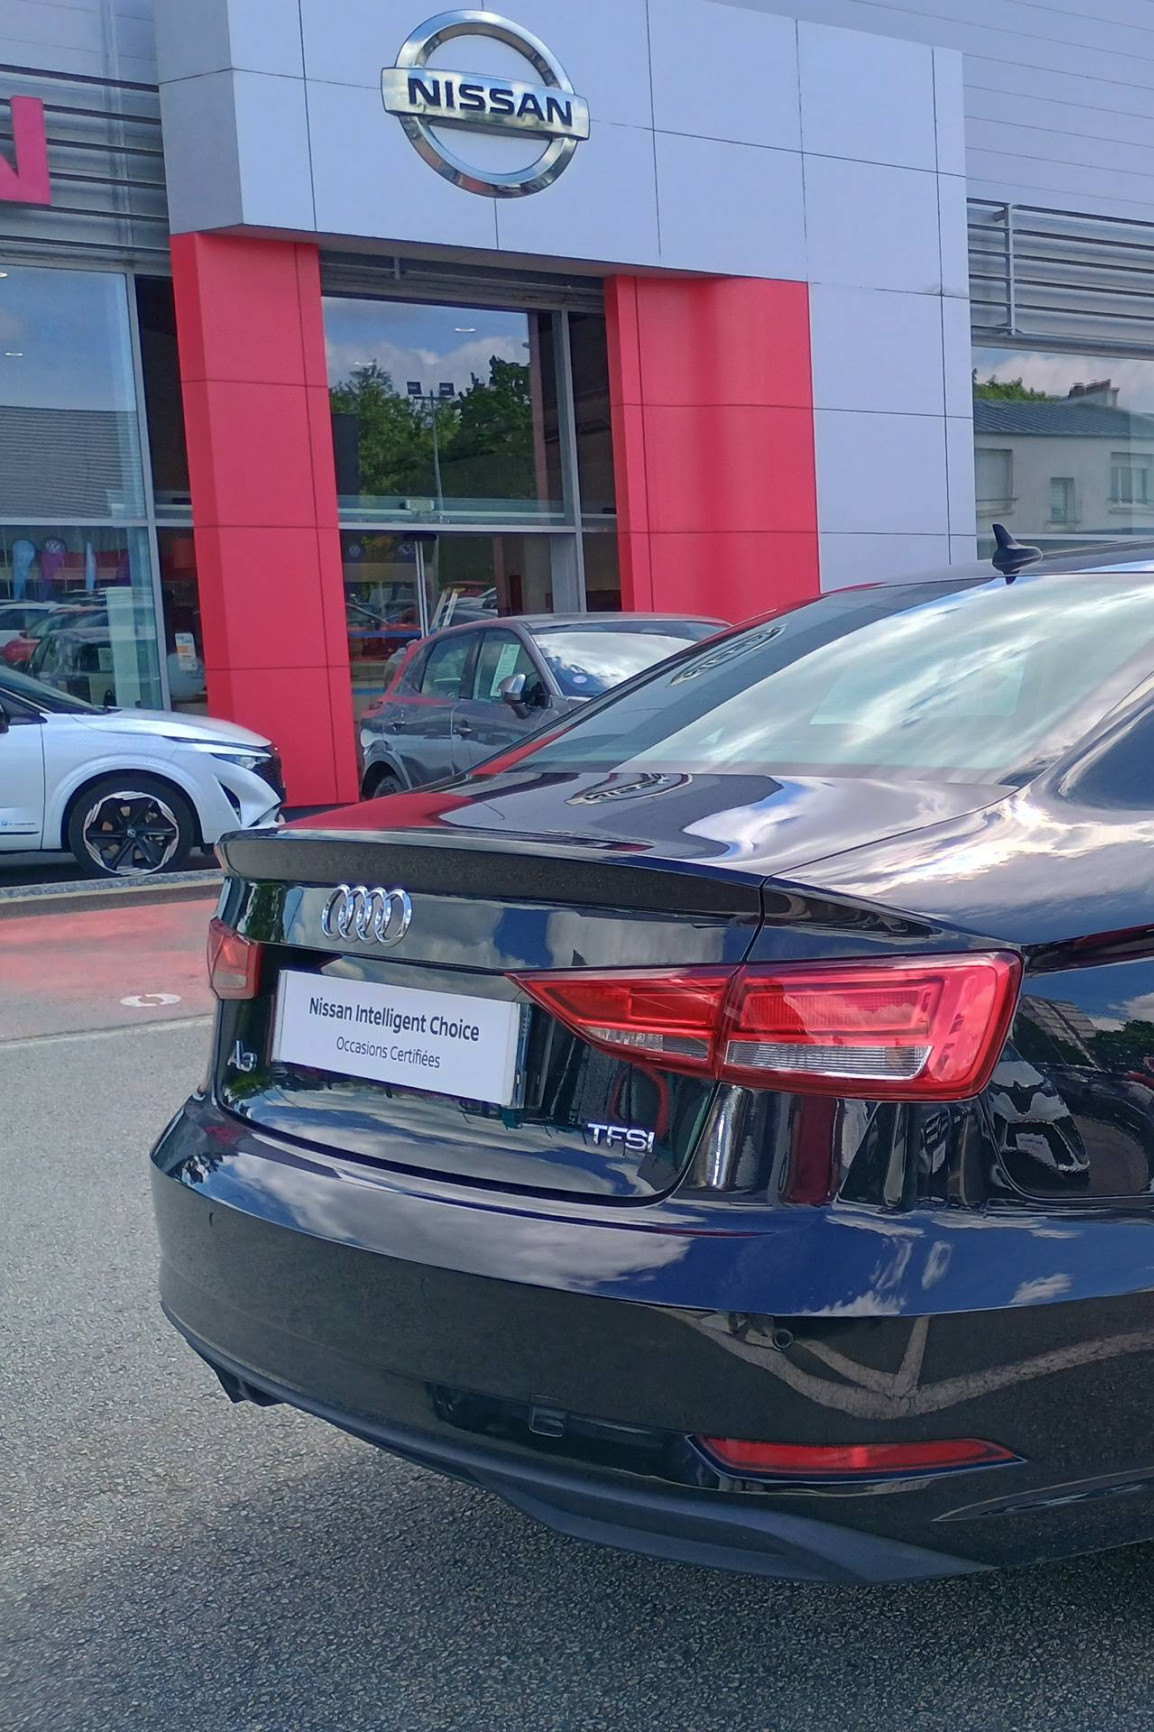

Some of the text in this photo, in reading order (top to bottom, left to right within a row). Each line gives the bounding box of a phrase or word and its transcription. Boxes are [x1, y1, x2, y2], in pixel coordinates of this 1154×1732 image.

[408, 78, 572, 127] NISSAN
[309, 997, 480, 1042] Nissan Intelligent Choice
[336, 1036, 441, 1068] Occasions Certifiées
[587, 1123, 655, 1153] TFSI
